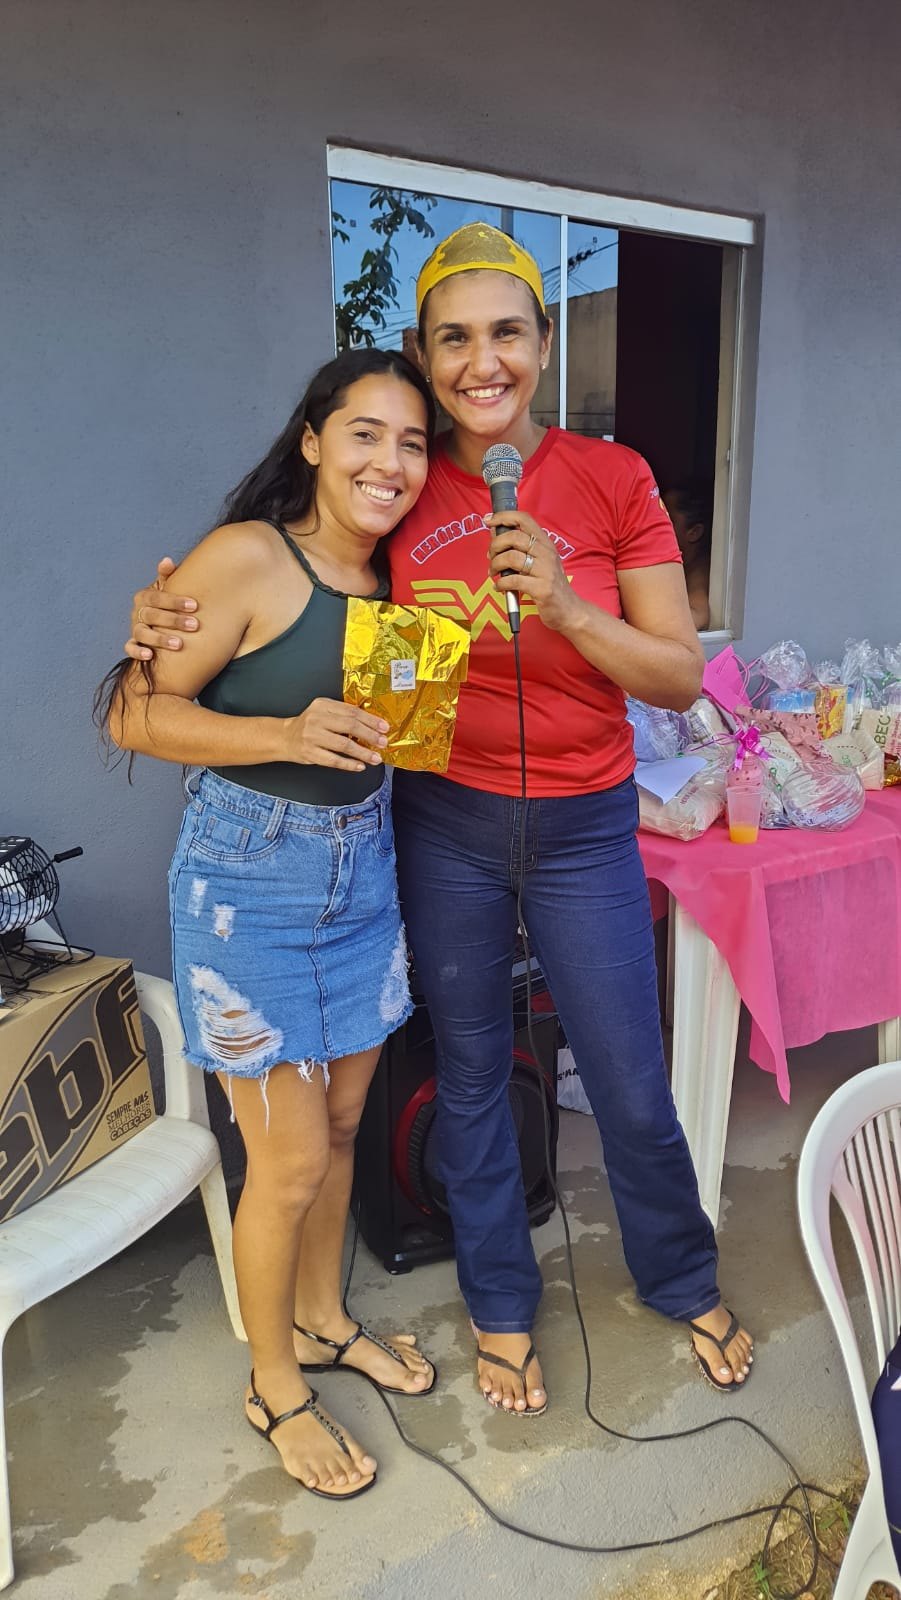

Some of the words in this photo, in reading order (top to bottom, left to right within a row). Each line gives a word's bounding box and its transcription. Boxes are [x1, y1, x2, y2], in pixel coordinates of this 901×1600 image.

[106, 1101, 132, 1125] SEMPRE
[134, 1091, 149, 1107] NAS
[107, 1099, 151, 1131] MELHORES
[110, 1108, 152, 1141] CABEÇAS
